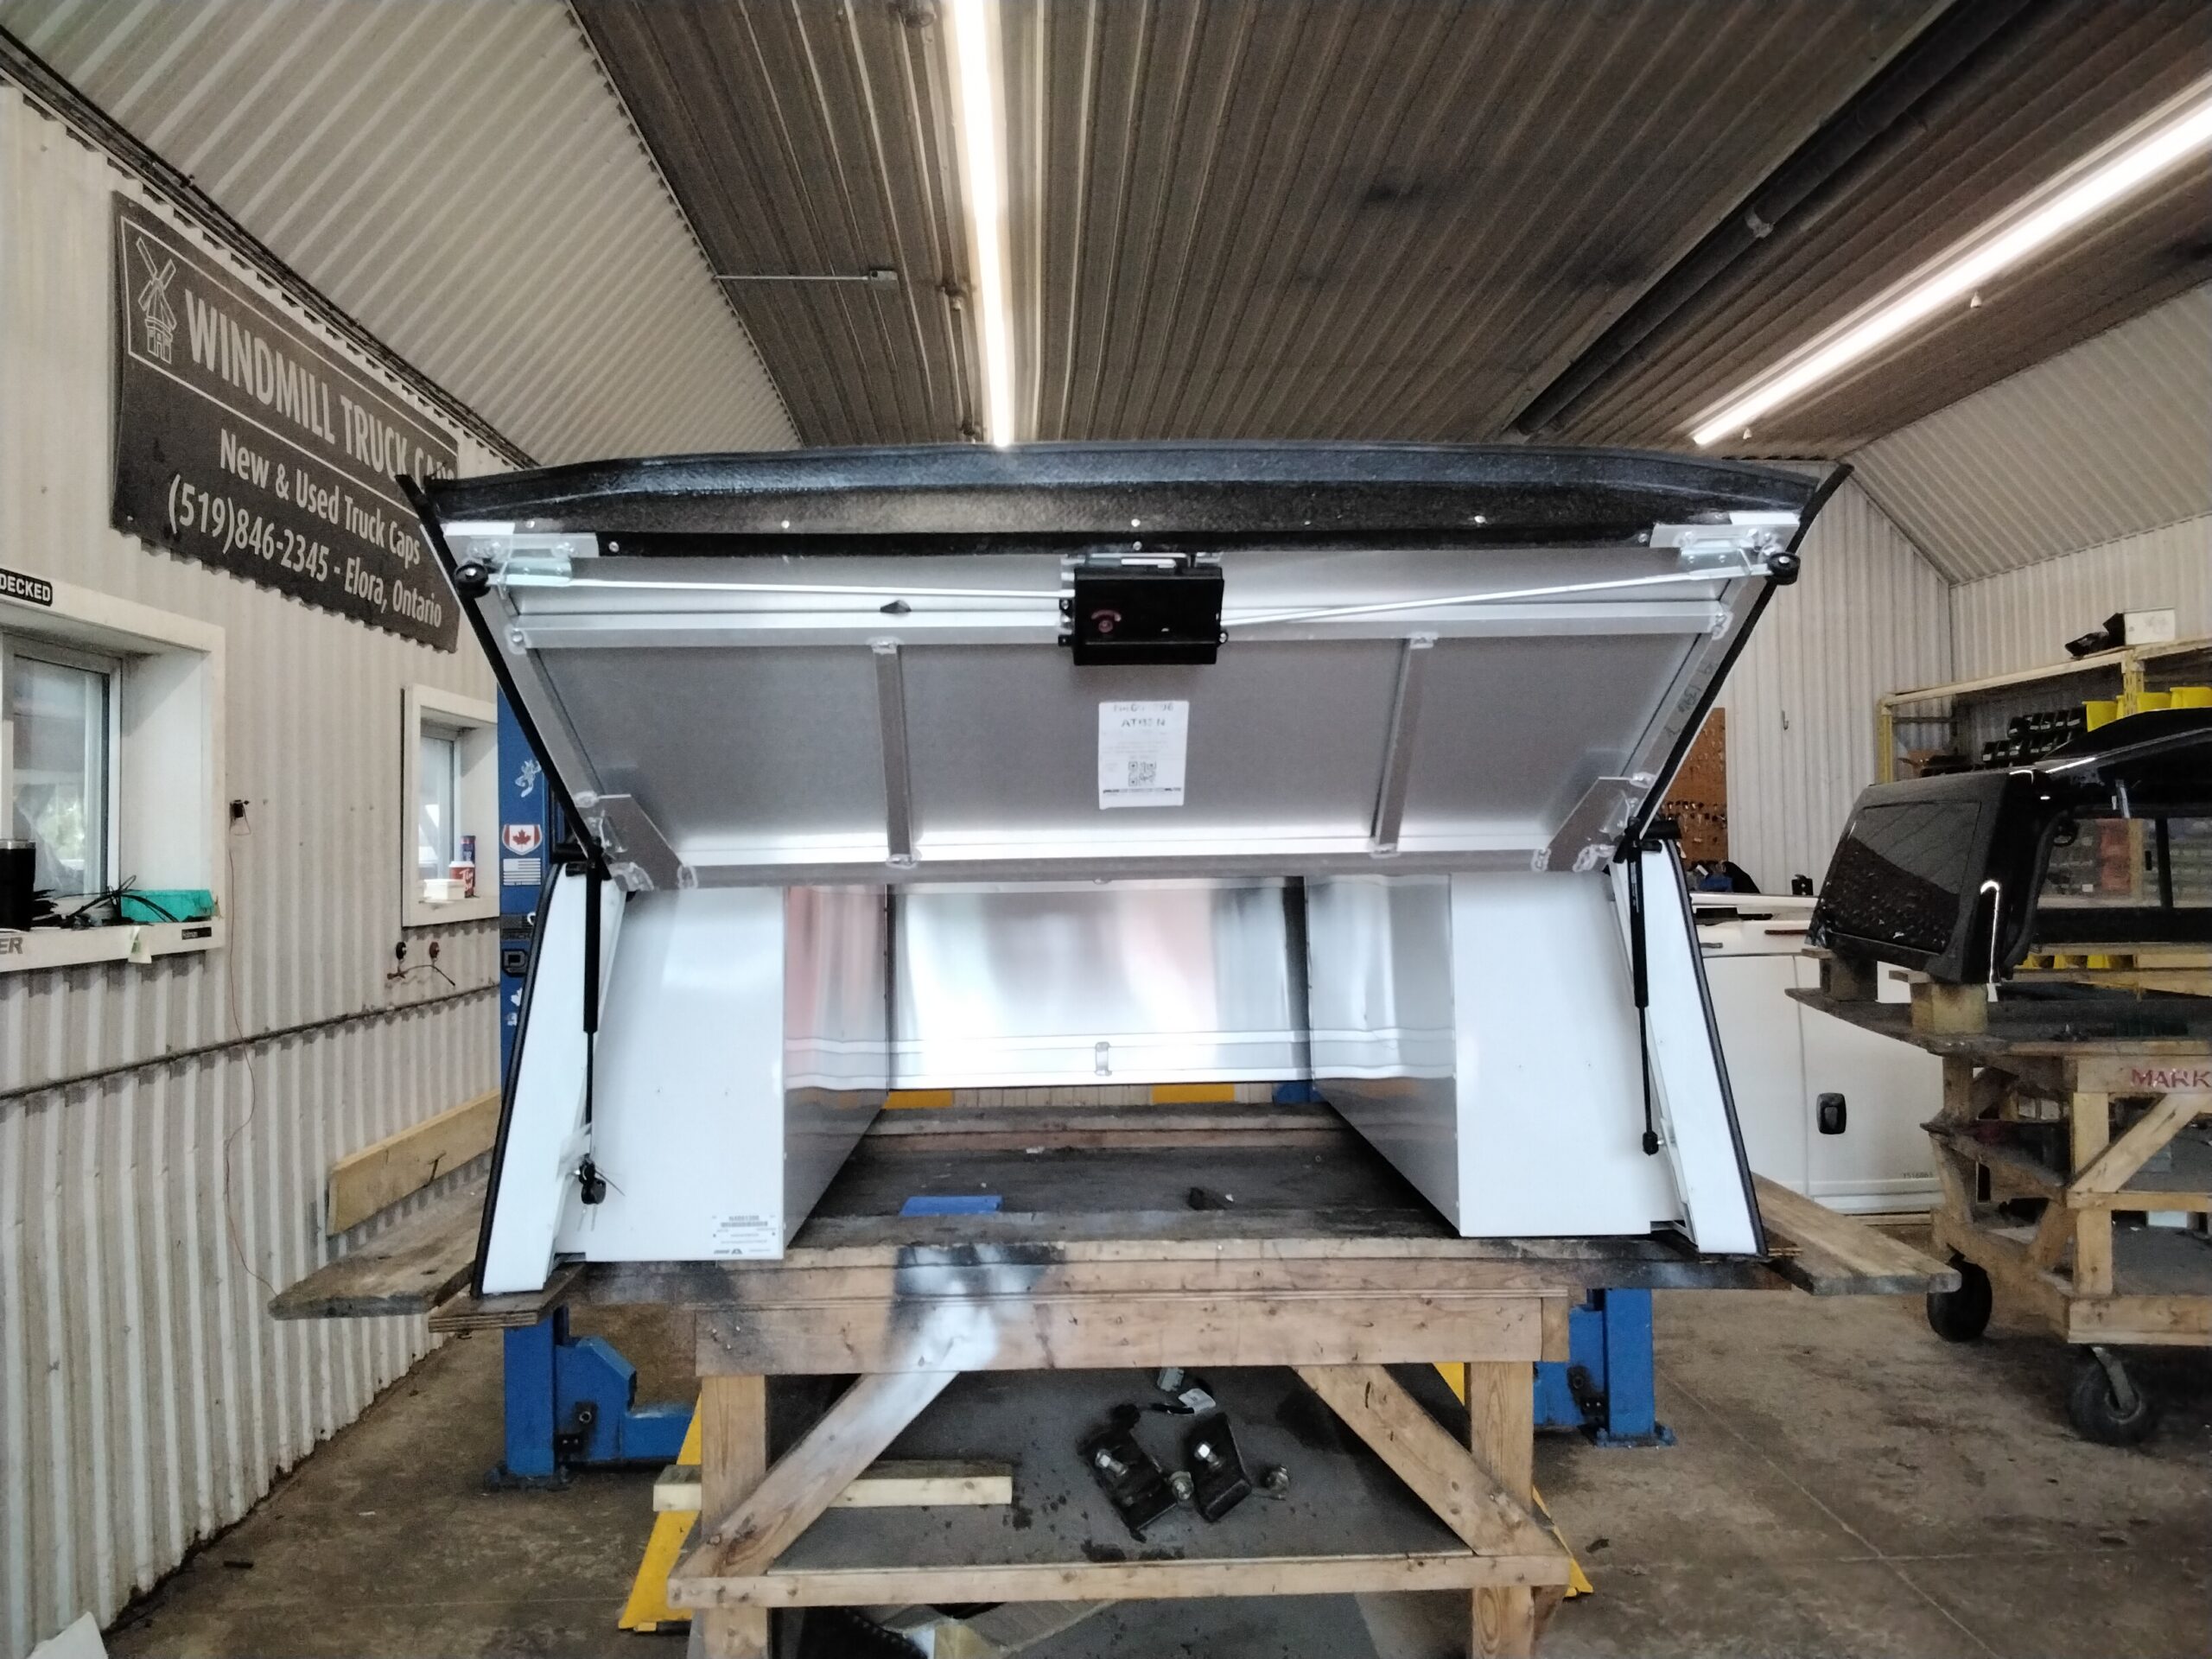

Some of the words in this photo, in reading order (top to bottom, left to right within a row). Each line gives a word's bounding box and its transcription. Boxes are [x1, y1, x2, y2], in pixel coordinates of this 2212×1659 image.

[185, 289, 335, 444] WINDMILL
[340, 394, 408, 481] TRUCK
[168, 474, 330, 582] (519)846-2345
[345, 556, 388, 613] Elora,
[392, 580, 442, 628] Ontario
[220, 428, 270, 489] New
[276, 463, 289, 500] &
[296, 467, 340, 525] Used
[344, 494, 385, 550] Truck
[390, 520, 421, 569] Caps
[0, 573, 51, 601] DECKED
